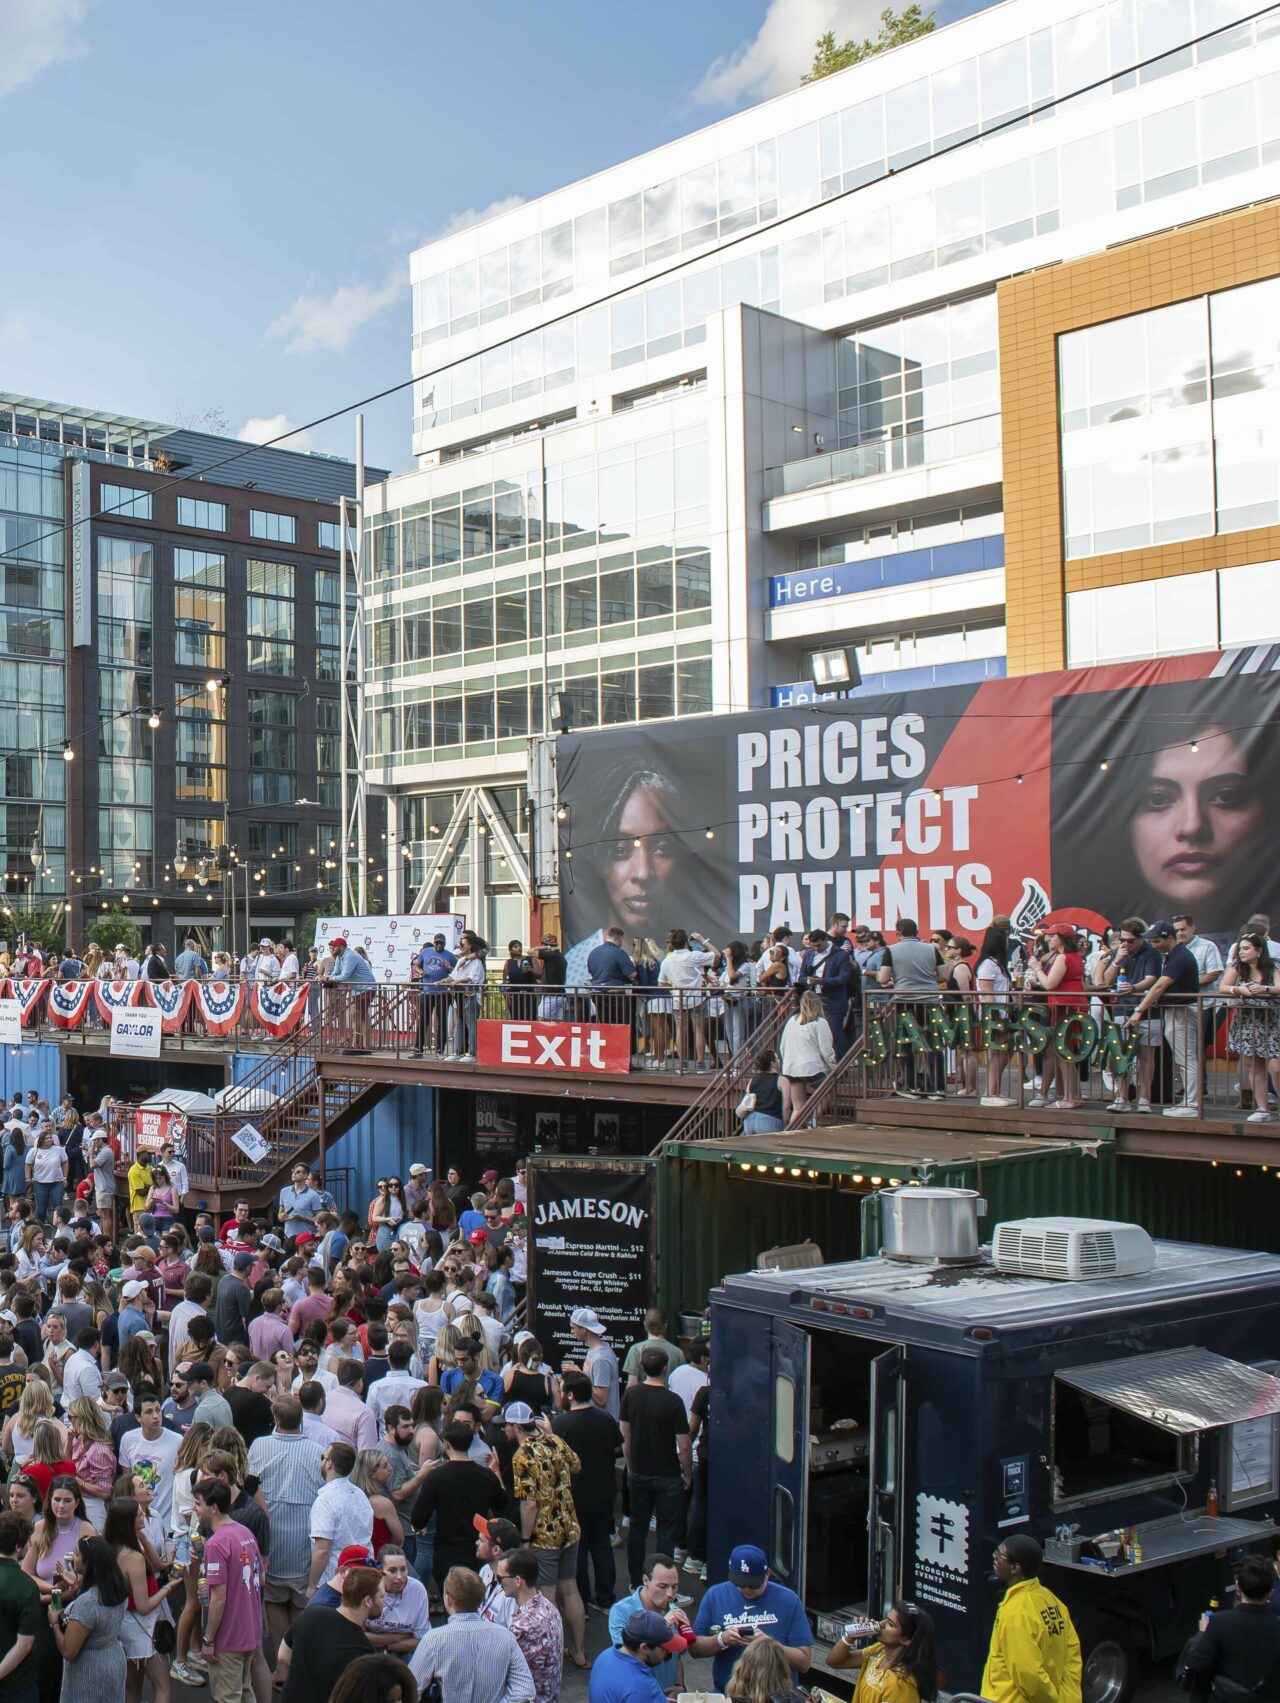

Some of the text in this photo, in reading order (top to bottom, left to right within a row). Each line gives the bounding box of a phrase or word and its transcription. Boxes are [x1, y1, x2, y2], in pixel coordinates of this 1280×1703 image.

[72, 482, 83, 624] HOMEWOOD SUITES
[776, 577, 842, 601] Here,
[738, 713, 926, 792] PRICES
[738, 785, 979, 862] PROTECT
[738, 863, 995, 934] PATIENTS
[116, 1023, 154, 1037] GAYLOR
[862, 1002, 1142, 1076] JAMESON
[501, 1023, 607, 1069] Exit
[142, 1112, 162, 1124] UPPER
[142, 1123, 159, 1135] DECK
[535, 1198, 646, 1229] JAMESON
[565, 1243, 594, 1251] Espresso
[595, 1243, 620, 1251] Martini
[630, 1244, 644, 1252] $12
[542, 1269, 572, 1277] Jameson
[572, 1270, 597, 1279] Orange
[597, 1271, 618, 1279] Crush
[577, 1278, 602, 1286] Orange
[558, 1339, 584, 1347] Jameson
[915, 1563, 969, 1585] GEORGETOWN
[915, 1570, 943, 1584] EVENTS
[922, 1592, 967, 1613] @SURFSIDEDC
[923, 1584, 961, 1602] @MILLIESDC
